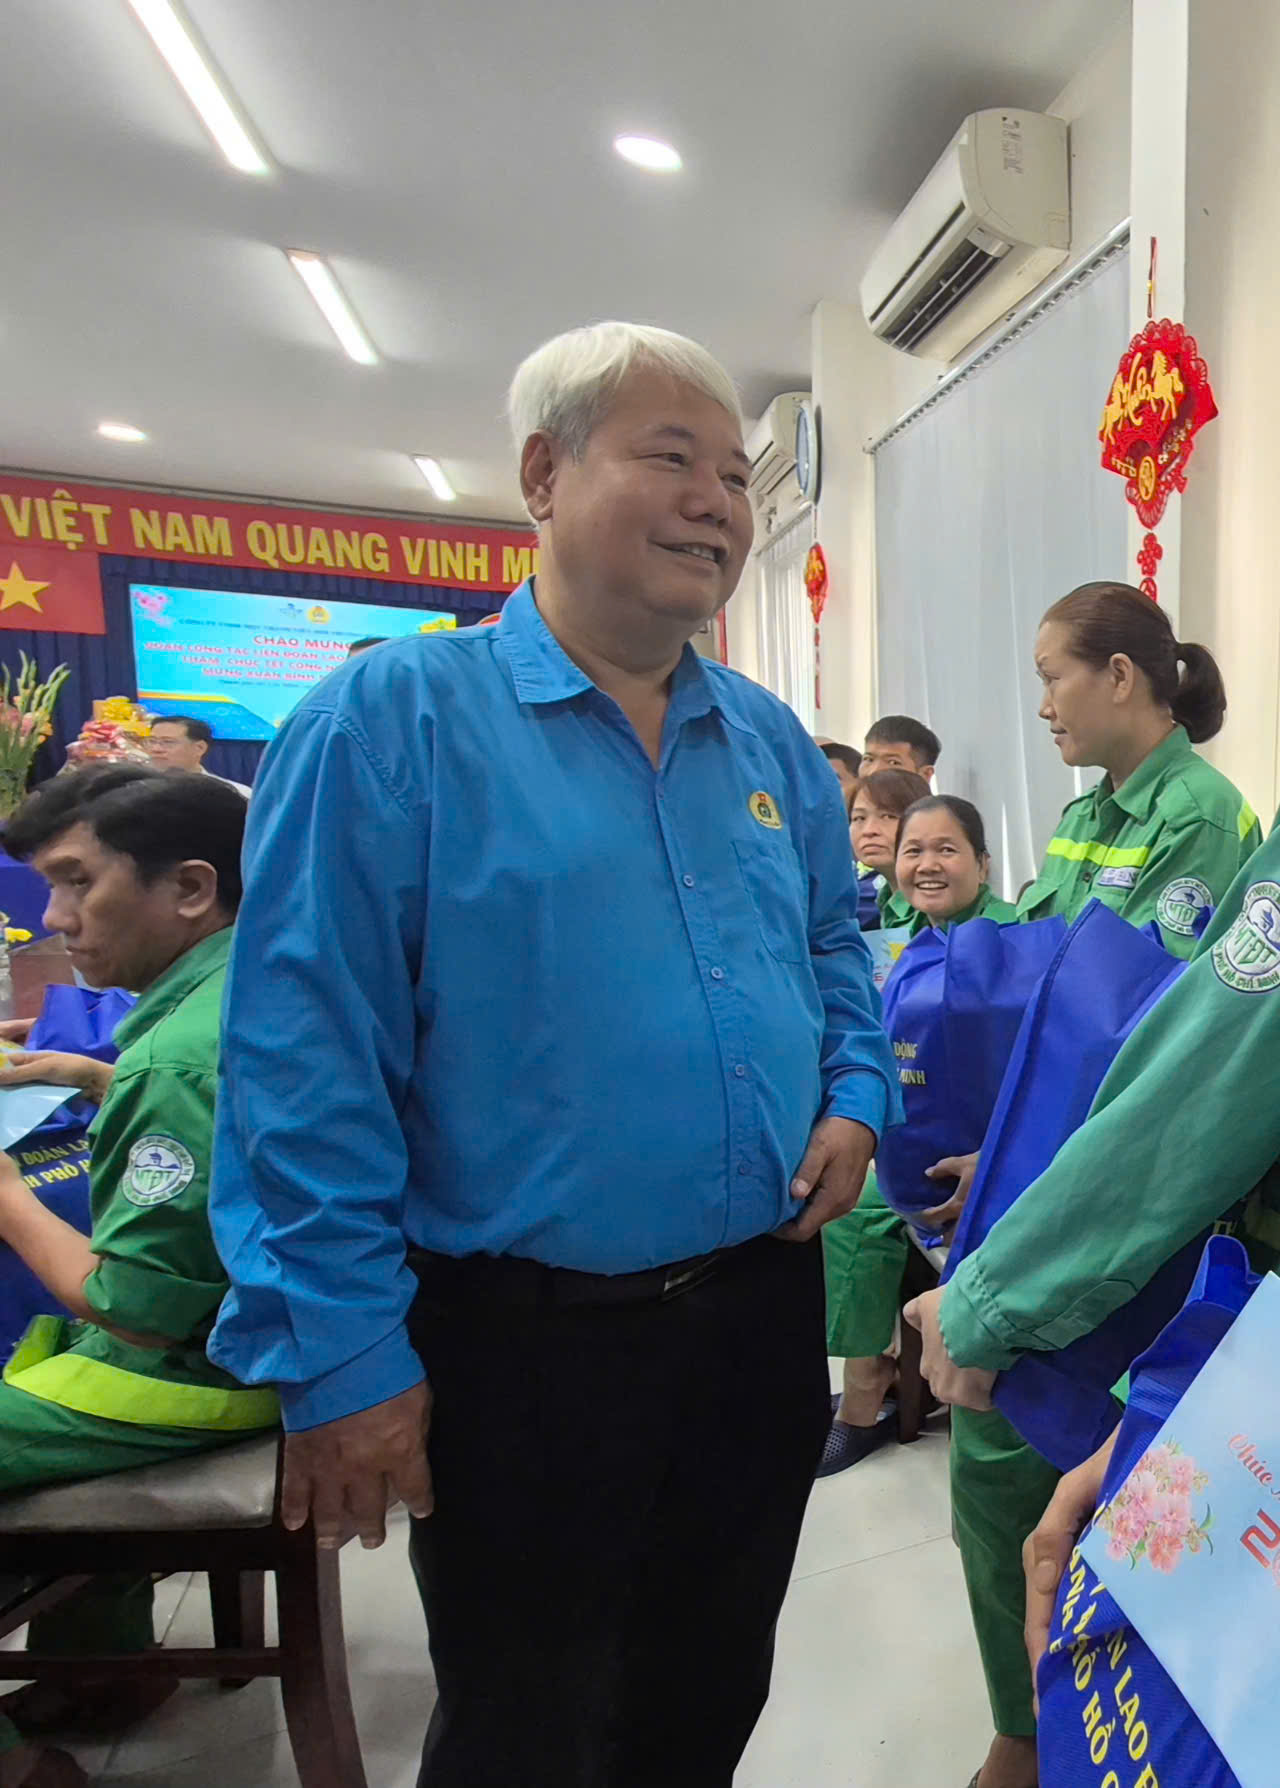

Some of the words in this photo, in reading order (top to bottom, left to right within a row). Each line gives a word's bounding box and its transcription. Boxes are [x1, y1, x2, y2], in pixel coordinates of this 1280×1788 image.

[1, 488, 112, 551] VIỆT
[129, 508, 233, 557] NAM
[246, 520, 390, 573] QUANG
[399, 536, 489, 583] VINH
[1082, 1690, 1116, 1765] HỒ
[1114, 1665, 1148, 1761] LAO
